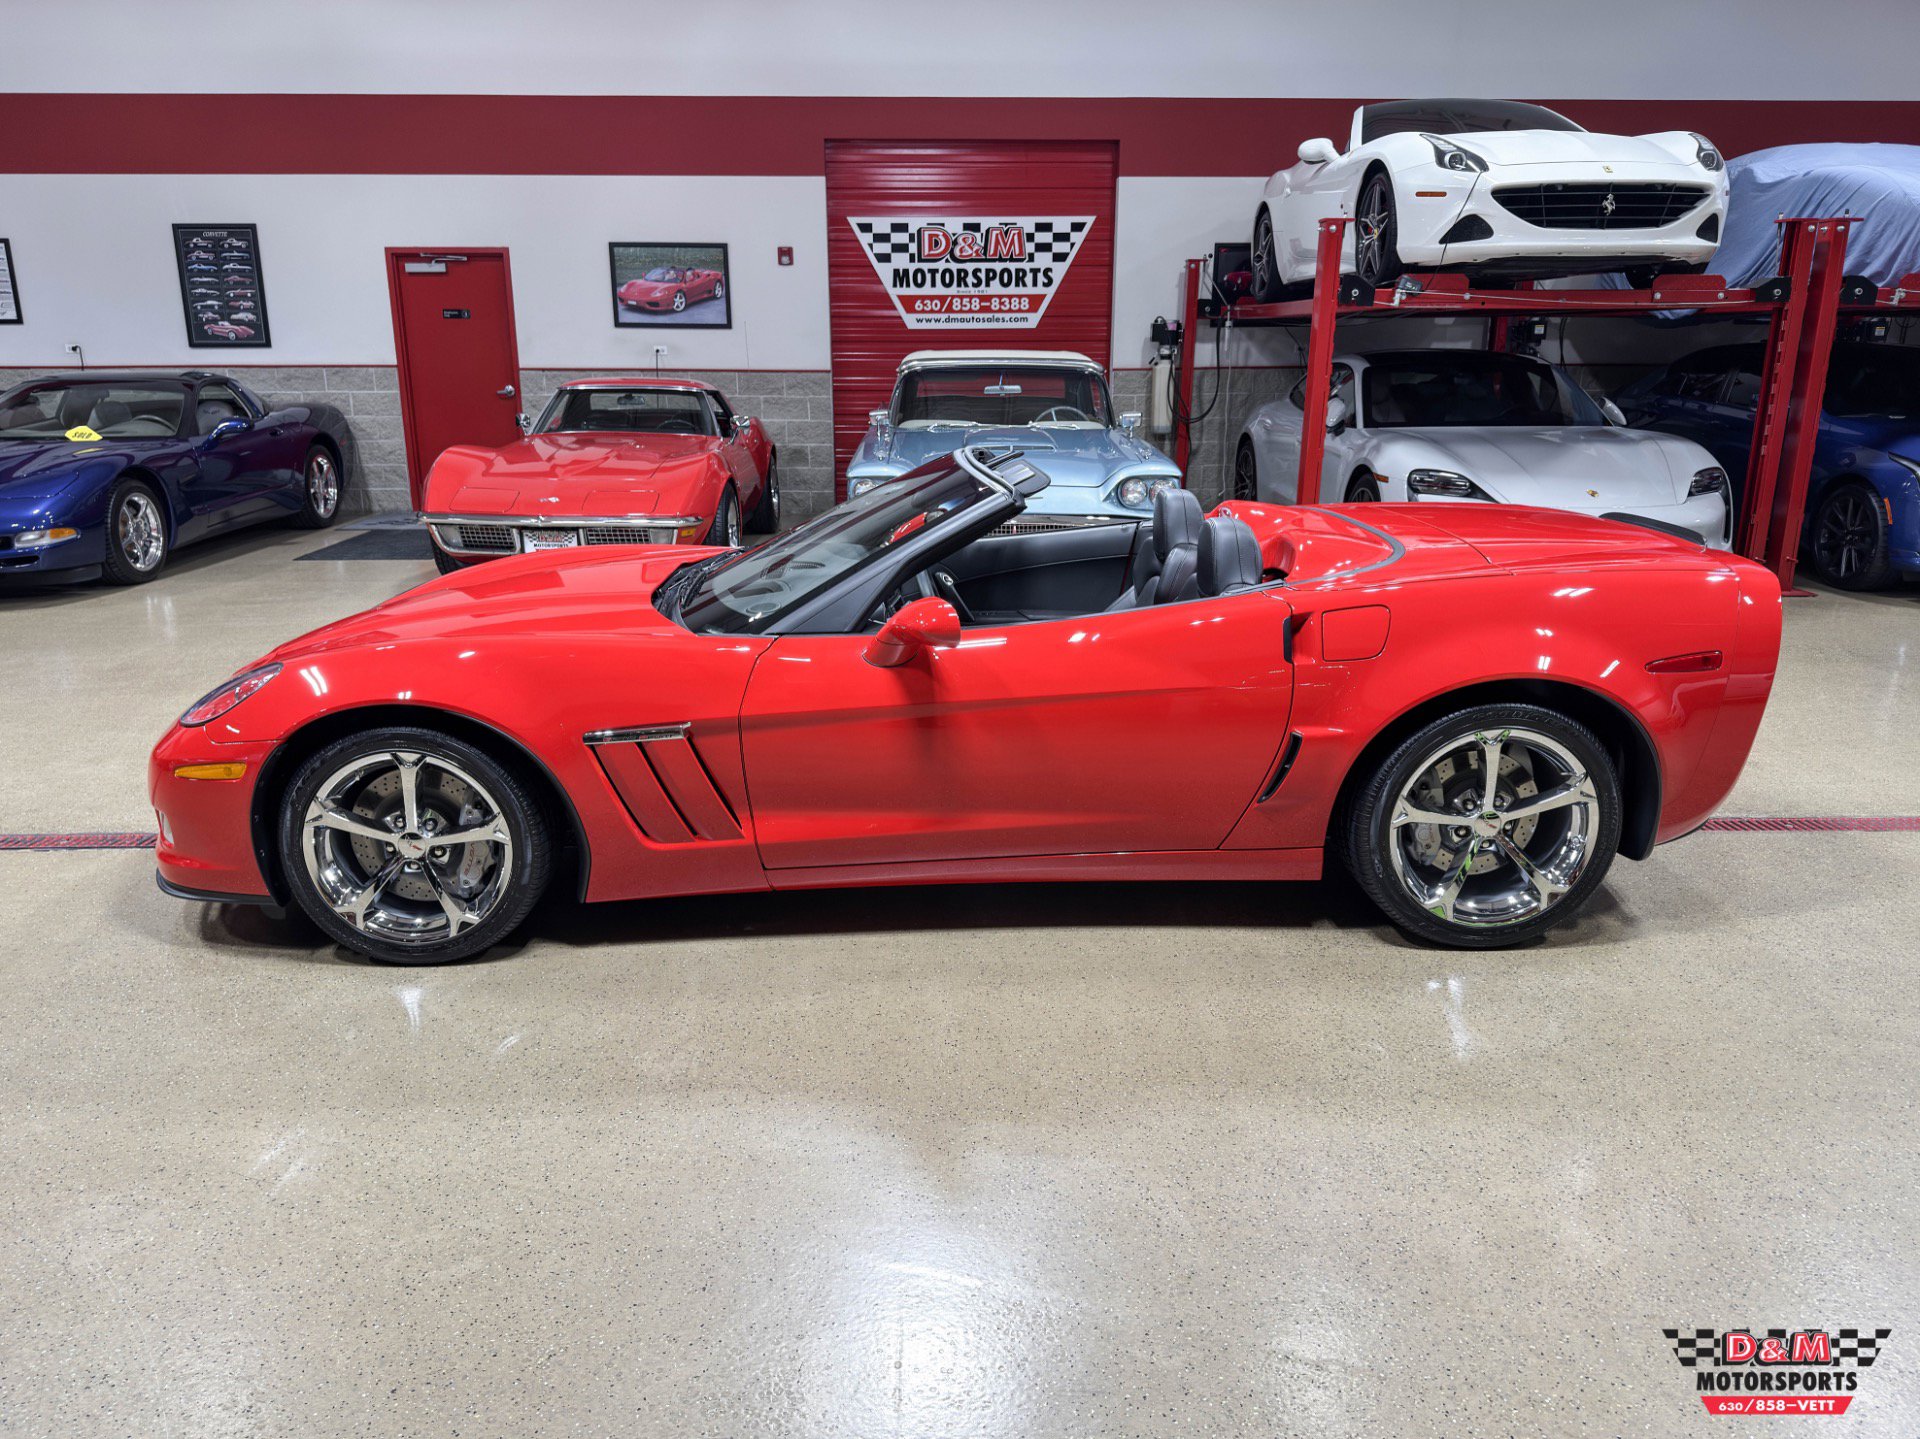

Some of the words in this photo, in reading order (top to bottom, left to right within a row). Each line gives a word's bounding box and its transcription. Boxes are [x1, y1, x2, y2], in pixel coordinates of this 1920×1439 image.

[917, 227, 1026, 262] D&M
[892, 267, 1054, 289] MOTORSPORTS
[915, 315, 1029, 324] www.dmautosales.com
[71, 431, 92, 439] SOLD
